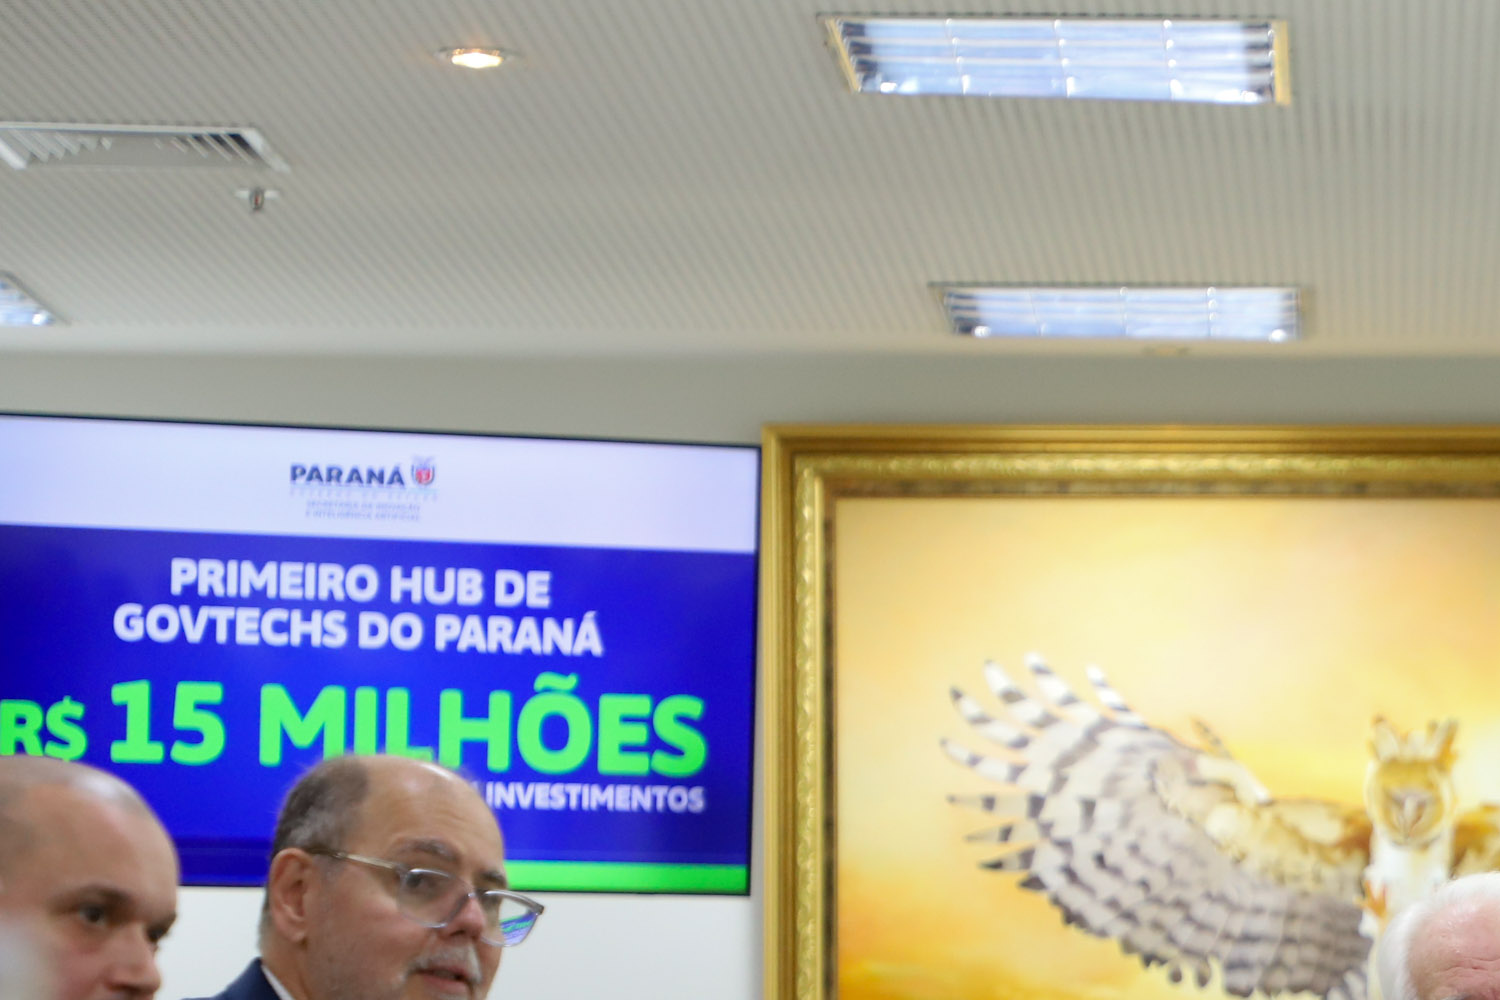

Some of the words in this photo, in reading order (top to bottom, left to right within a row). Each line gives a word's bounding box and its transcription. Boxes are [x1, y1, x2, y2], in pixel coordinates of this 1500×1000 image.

[290, 465, 405, 487] PARANÁ
[170, 557, 379, 603] PRIMEIRO
[390, 565, 484, 607] HUB
[494, 569, 552, 609] DE
[113, 602, 348, 649] GOVTECHS
[358, 610, 423, 651] DO
[434, 610, 605, 657] PARANÁ
[0, 695, 88, 762] R$
[110, 679, 226, 766] 15
[259, 671, 708, 777] MILHÕES
[486, 781, 706, 813] INVESTIMENTOS
